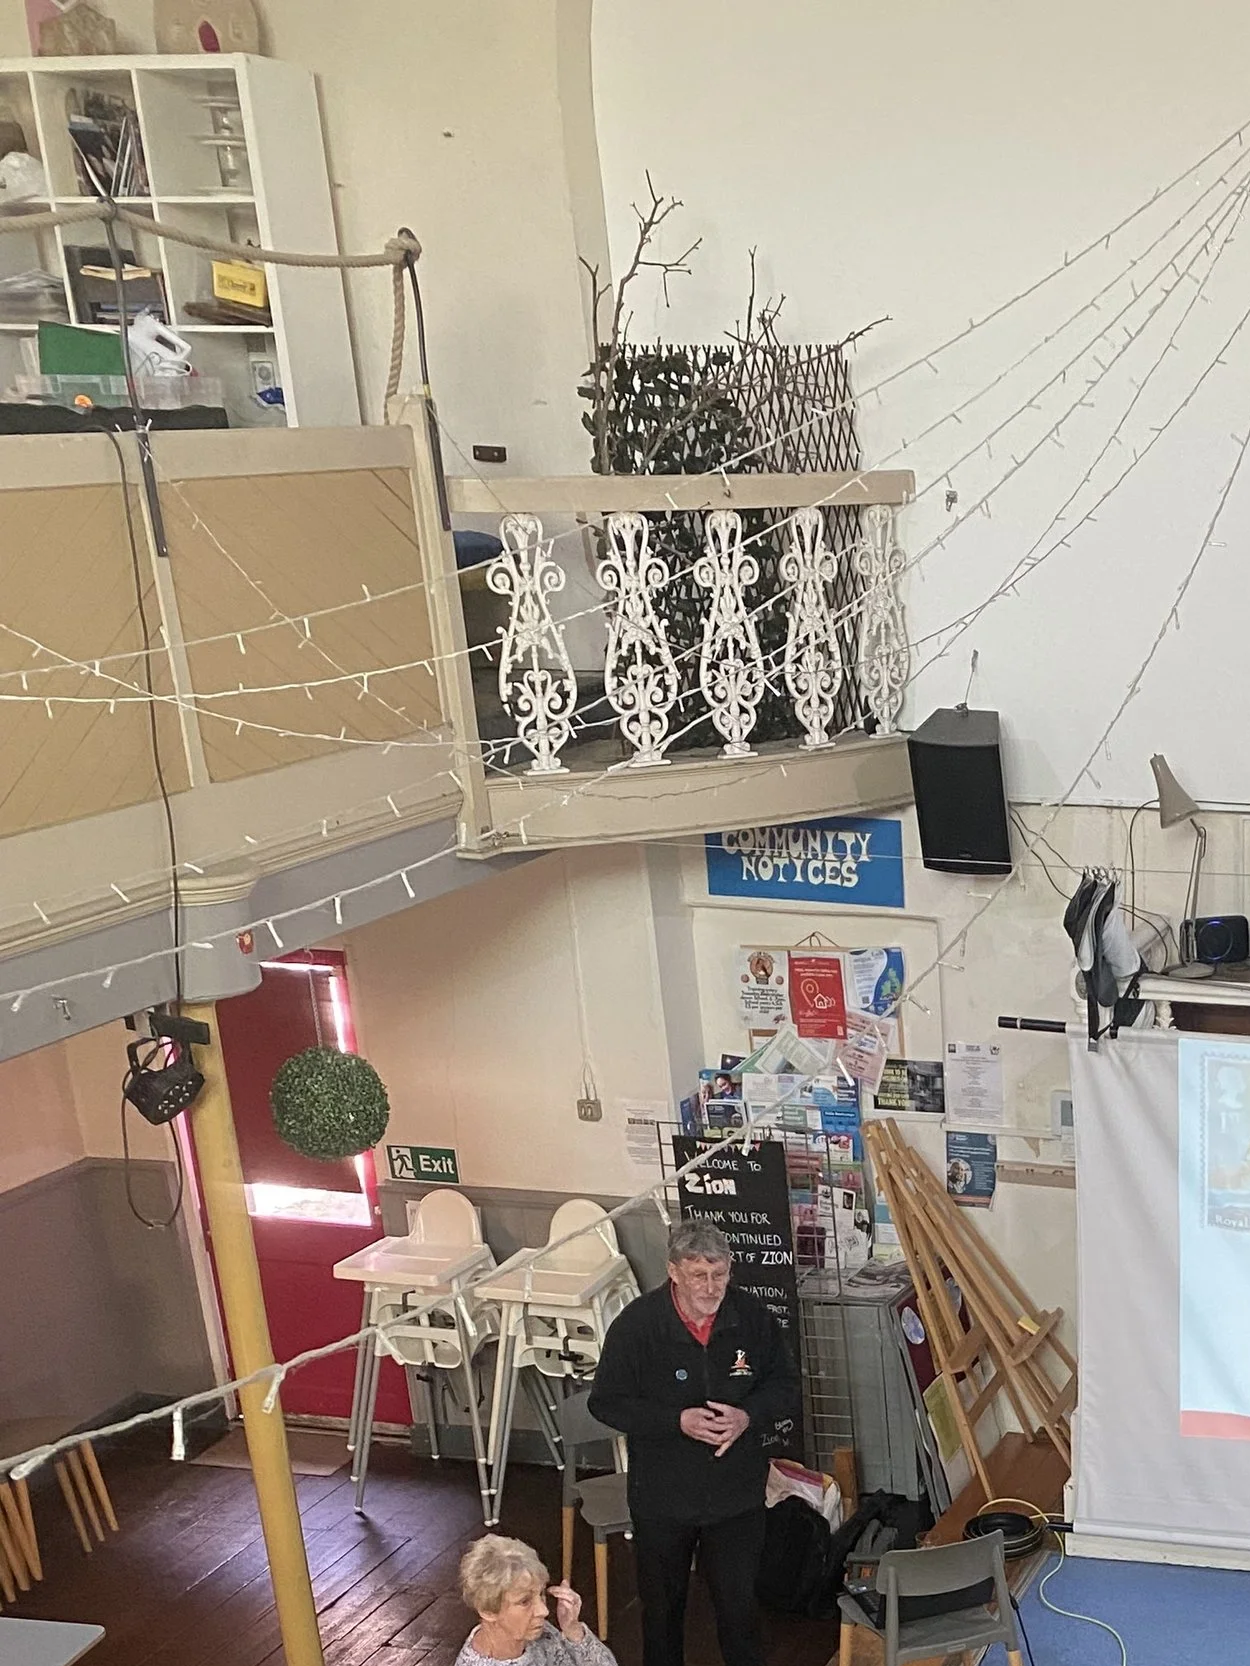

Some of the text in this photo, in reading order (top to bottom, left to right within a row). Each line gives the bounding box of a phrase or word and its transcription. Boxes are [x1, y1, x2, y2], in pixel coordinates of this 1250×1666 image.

[722, 827, 872, 862] COMMUNITY
[742, 856, 859, 888] NOTICES
[418, 1154, 455, 1174] Exit
[684, 1204, 771, 1225] THANK YOU FOR
[1215, 1214, 1249, 1228] Royal
[761, 1250, 793, 1265] ZION
